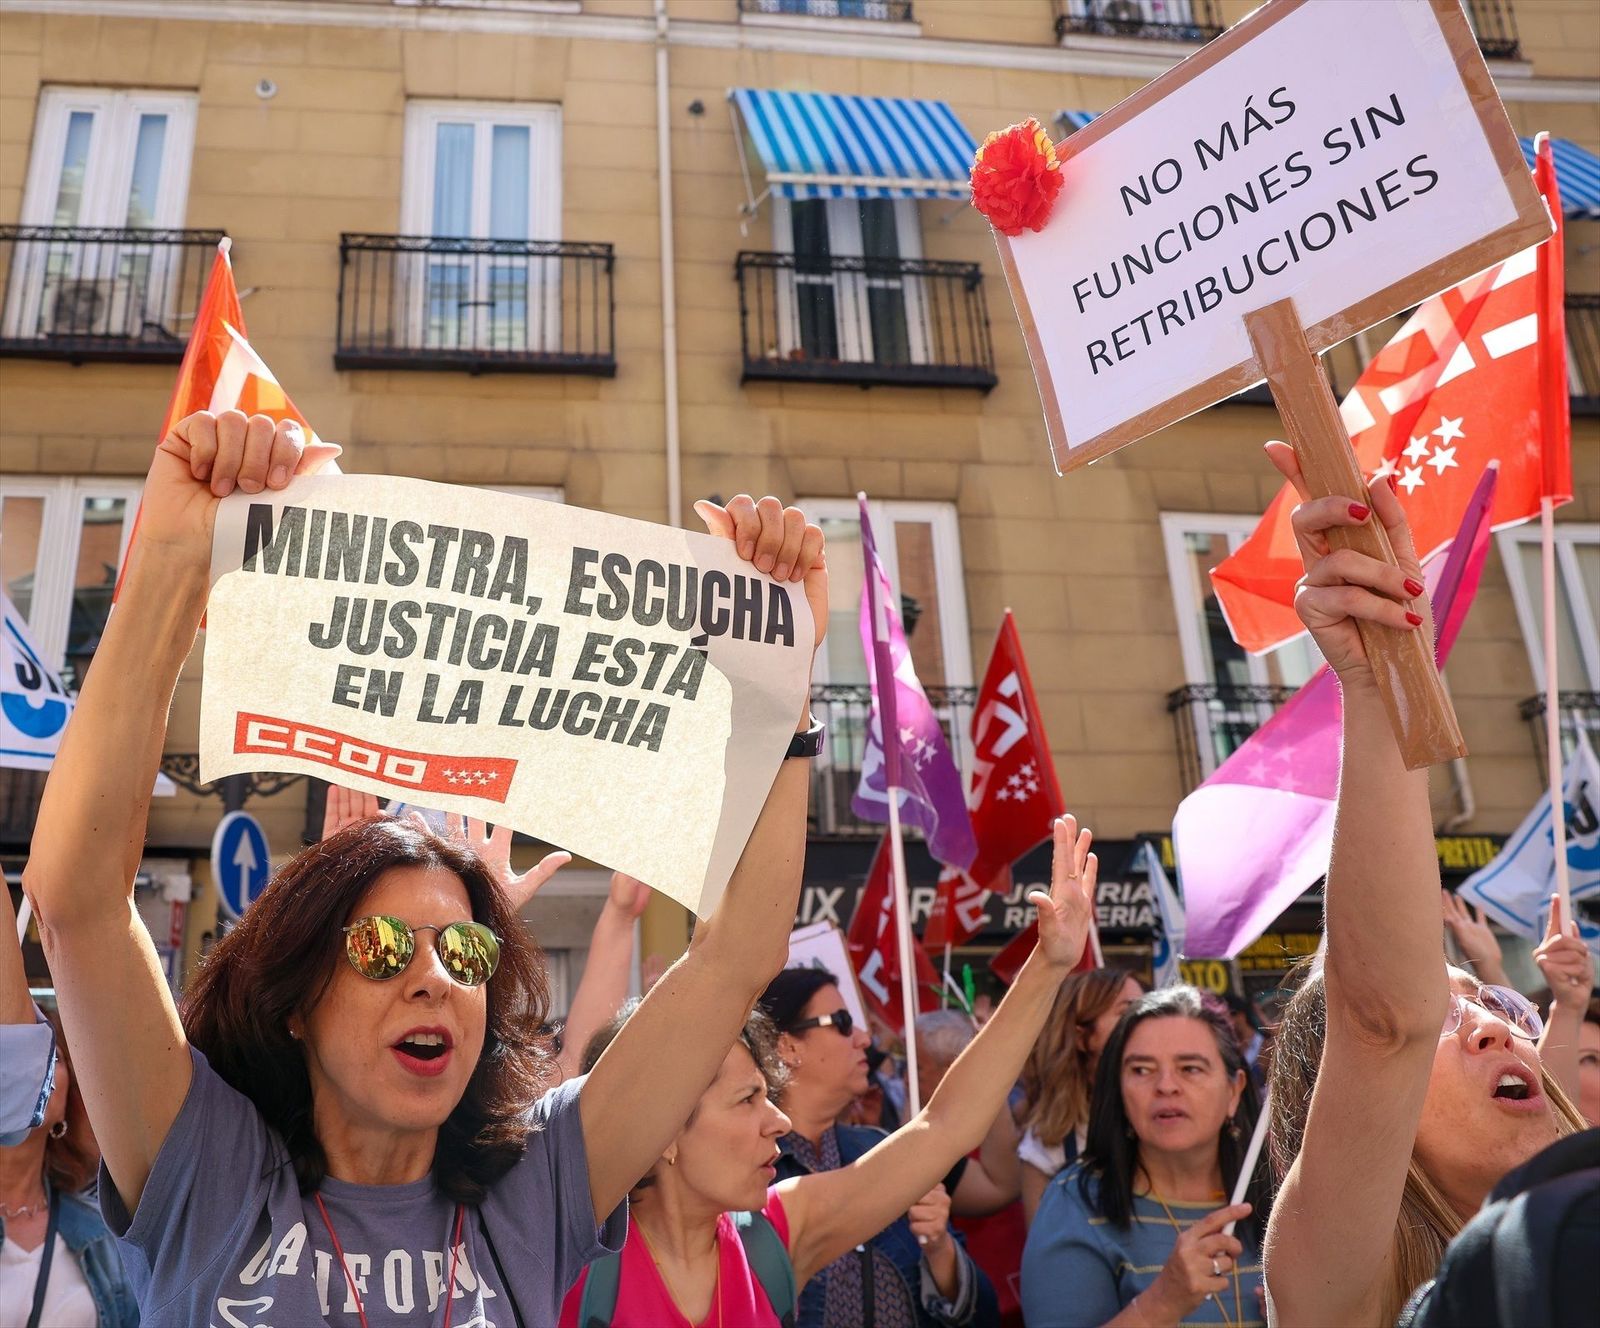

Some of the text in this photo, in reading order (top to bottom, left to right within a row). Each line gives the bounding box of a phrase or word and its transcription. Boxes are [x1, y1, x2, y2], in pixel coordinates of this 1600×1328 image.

[1071, 93, 1406, 314] FUNCIONES SIN
[1119, 86, 1296, 216] NO MÁS
[1087, 154, 1440, 375] RETRIBUCIONES
[242, 503, 796, 648] MINISTRA, ESCUCHA
[308, 596, 709, 701] JUSTICIA ESTÁ
[331, 664, 671, 753] EN LA LUCHA
[245, 720, 428, 785] CCOO
